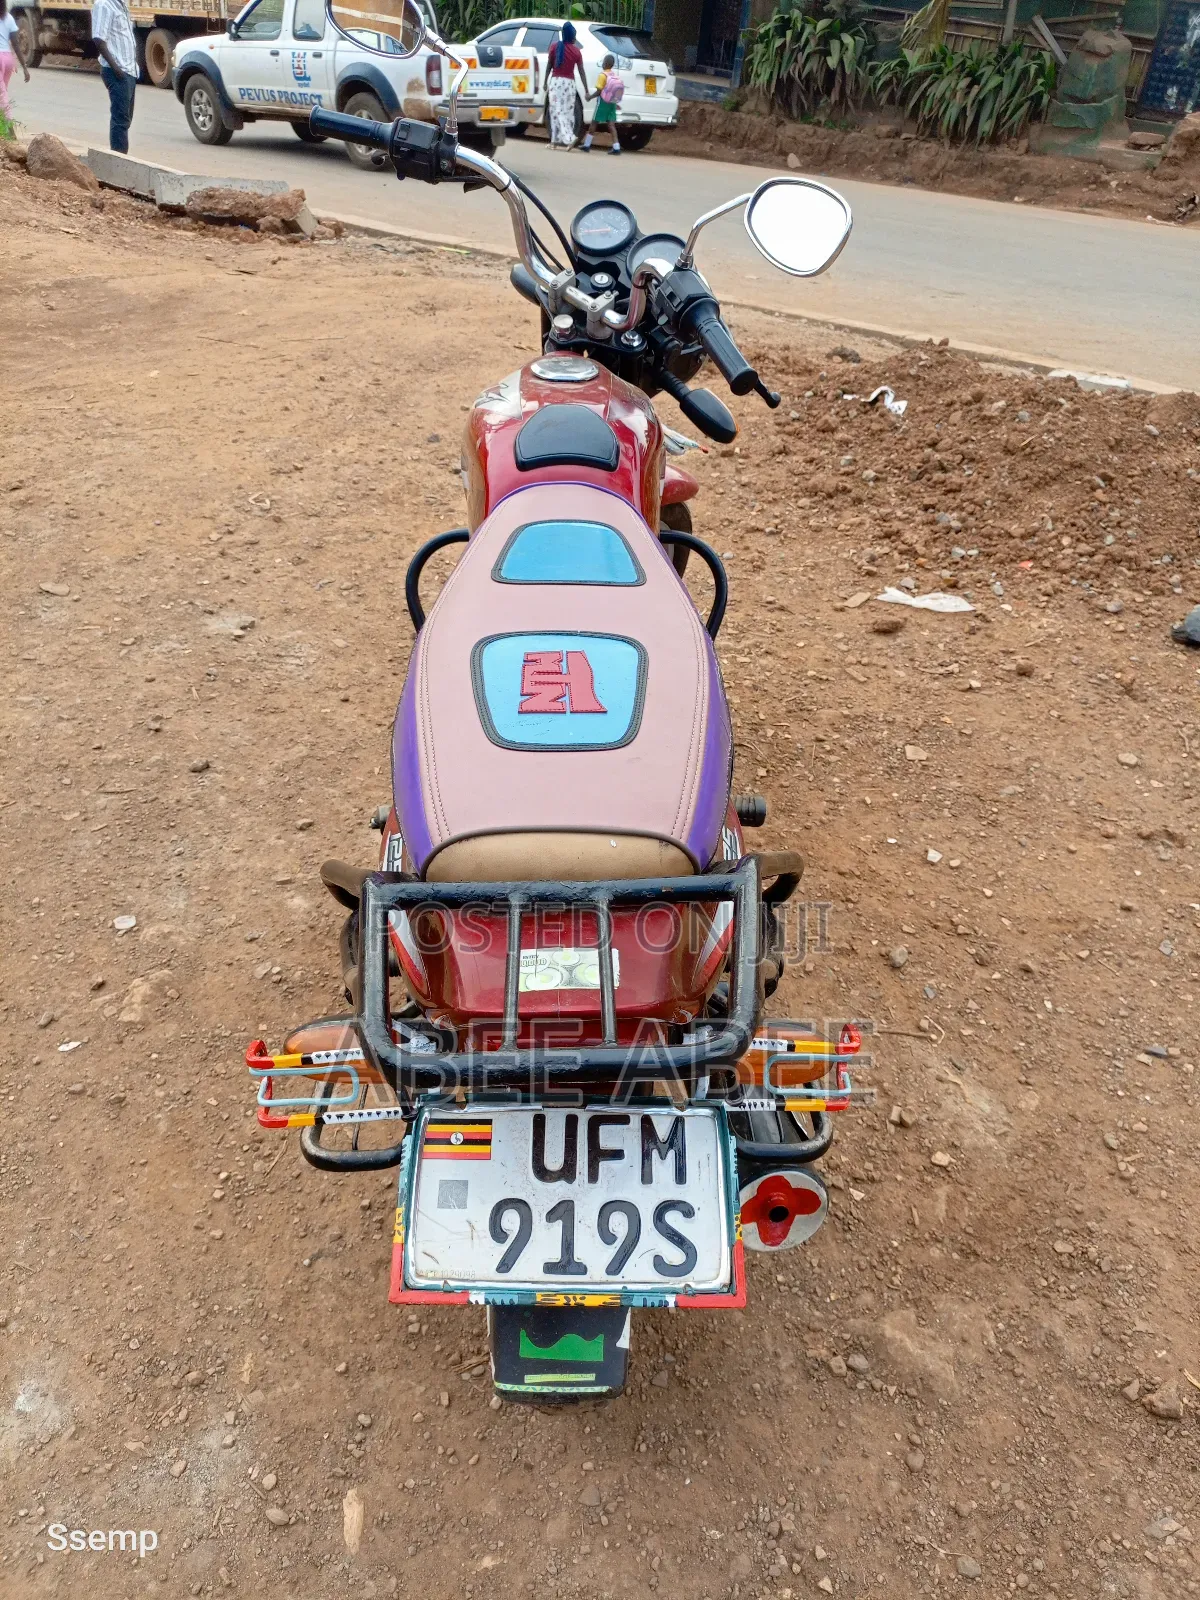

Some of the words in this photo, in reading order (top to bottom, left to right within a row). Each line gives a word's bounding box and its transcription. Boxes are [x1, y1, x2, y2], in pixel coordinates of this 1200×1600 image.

[238, 88, 276, 103] PEVUS
[277, 90, 323, 107] PROJECT
[532, 1113, 687, 1185] UFM
[489, 1197, 698, 1278] 919S
